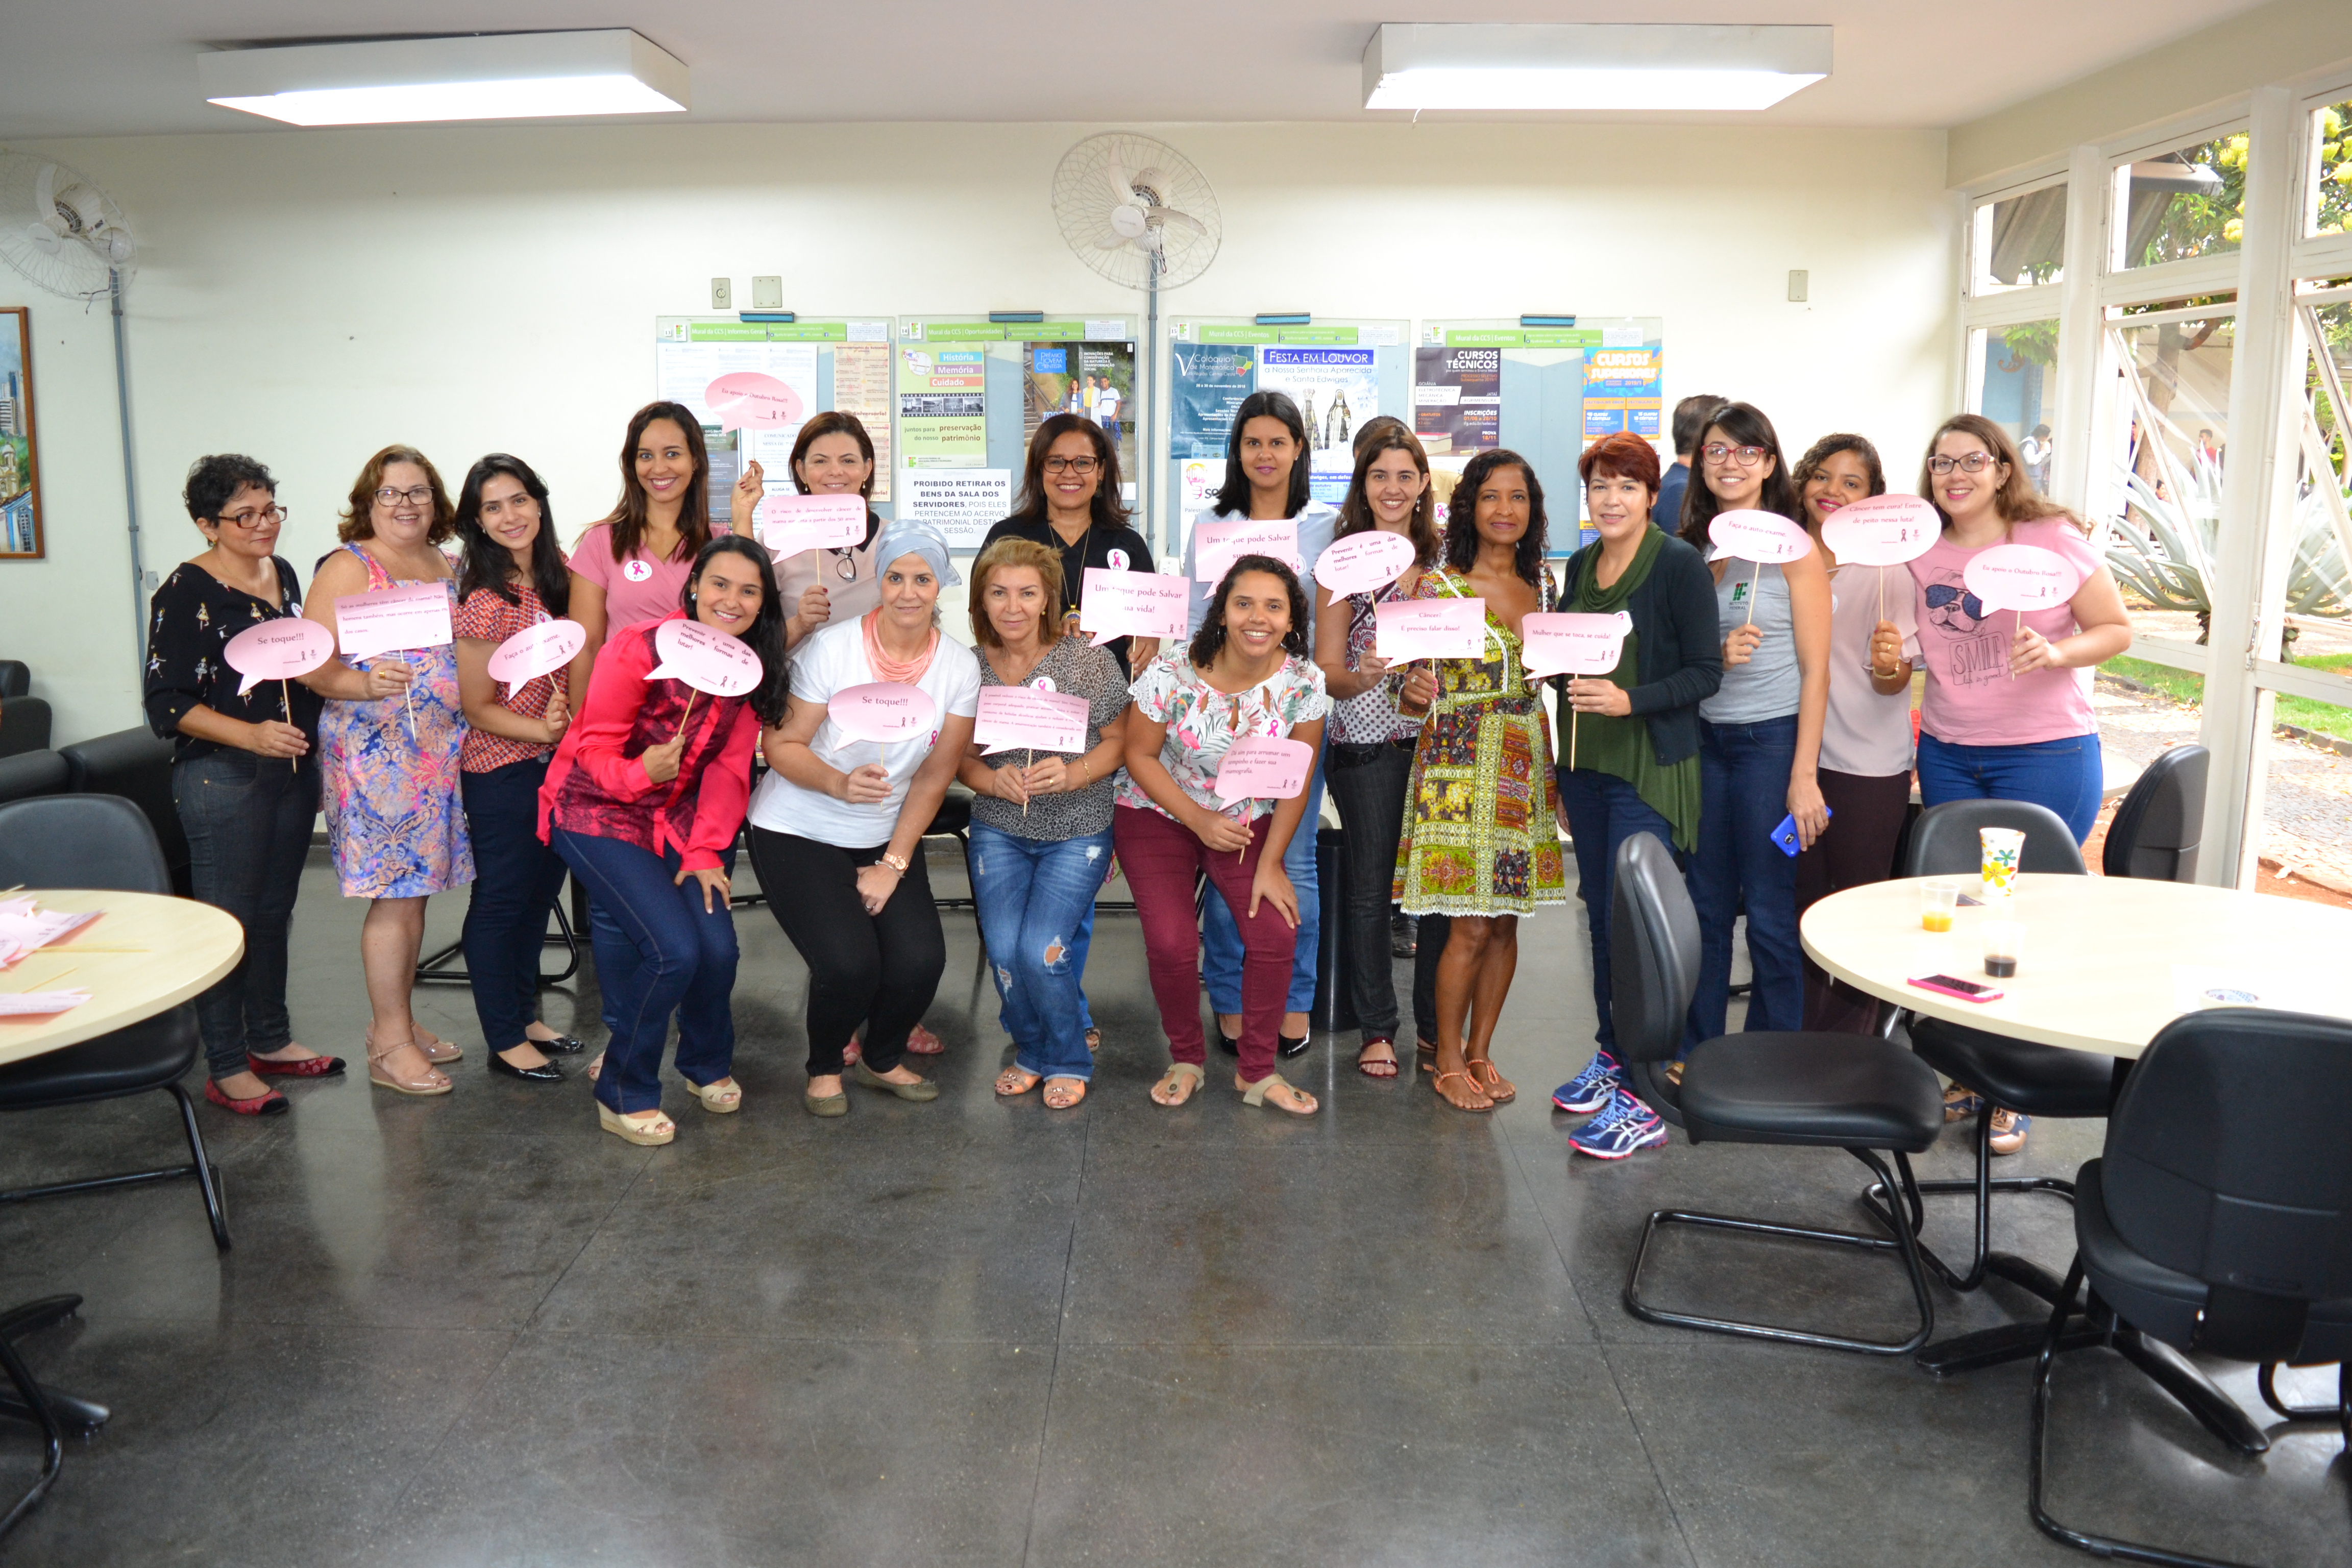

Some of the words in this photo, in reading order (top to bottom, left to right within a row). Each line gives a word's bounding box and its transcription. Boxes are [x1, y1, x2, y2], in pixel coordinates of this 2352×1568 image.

[965, 327, 1002, 336] Oportunidades
[1194, 354, 1231, 364] Colóquio
[1270, 352, 1300, 363] FESTA
[1304, 354, 1318, 363] EM
[1322, 352, 1368, 363] LOUVOR
[1458, 351, 1498, 359] CURSOS
[1597, 353, 1650, 366] CURSOS
[1446, 358, 1498, 369] TÉCNICOS
[1591, 368, 1657, 379] SUPERIORES
[749, 393, 770, 401] Outubro
[939, 424, 982, 432] preservação
[944, 526, 975, 534] SESSÃO.
[1729, 521, 1741, 530] Faça
[1749, 526, 1786, 537] auto-exame.
[1247, 534, 1265, 544] pode
[1268, 533, 1290, 542] Salvar
[1331, 546, 1353, 555] Prevenir
[1334, 555, 1357, 564] melhores
[1137, 588, 1156, 597] pode
[1159, 590, 1182, 599] Salvar
[1137, 605, 1155, 613] vida!
[271, 633, 304, 644] toque!!!
[682, 623, 706, 636] Prevenir
[723, 642, 735, 650] uma
[677, 639, 693, 650] lutar!
[680, 632, 705, 646] melhores
[714, 646, 733, 658] formas
[504, 652, 518, 660] Faça
[1953, 636, 2003, 675] SMILE
[1983, 669, 2000, 686] good
[875, 698, 908, 707] toque!!!
